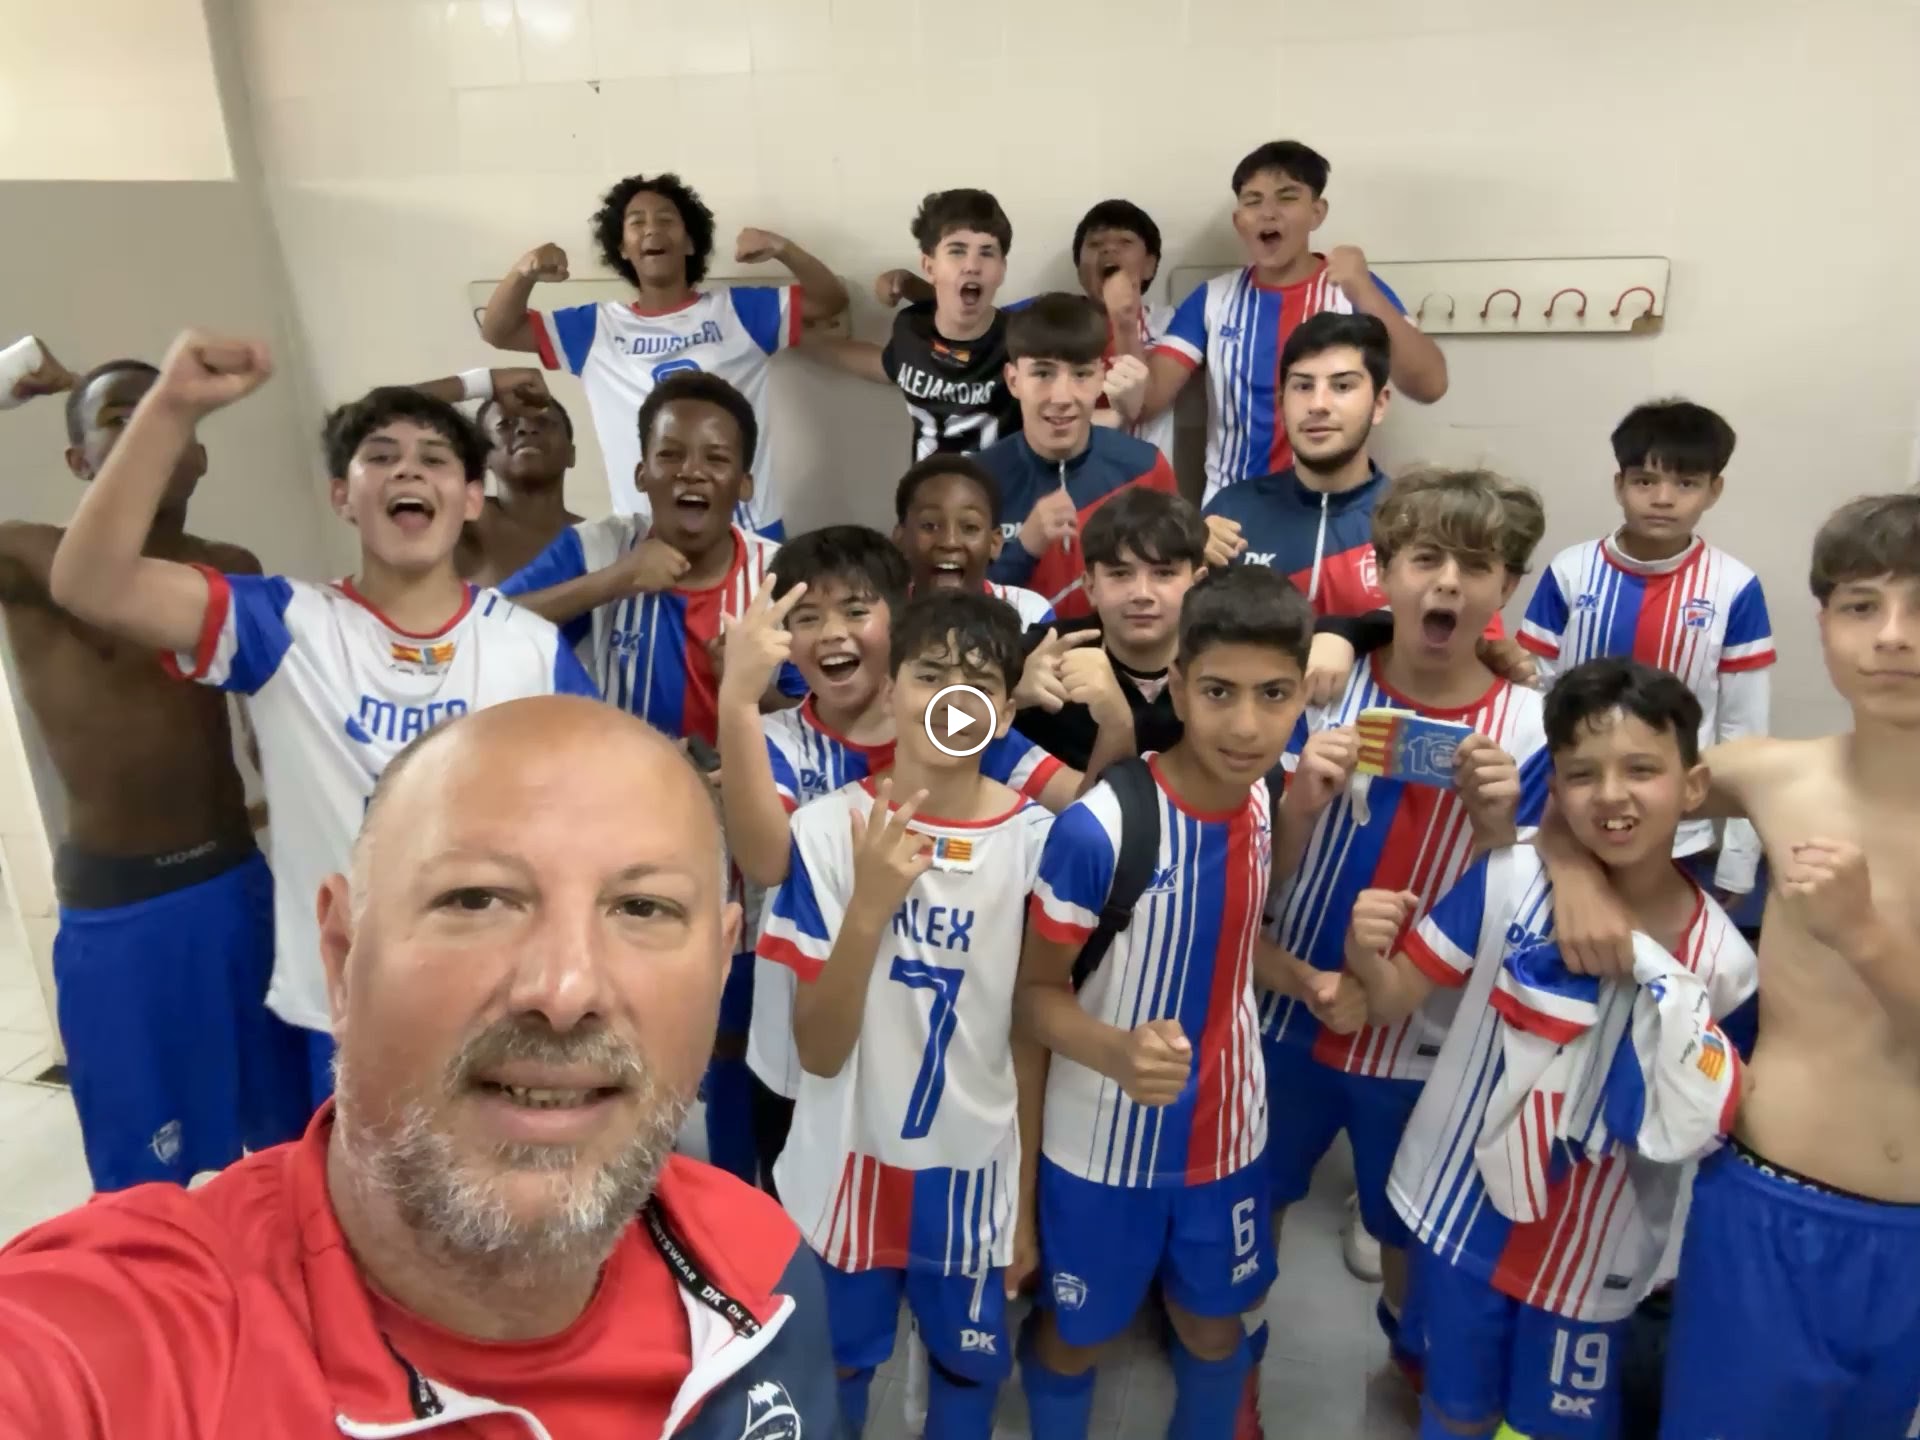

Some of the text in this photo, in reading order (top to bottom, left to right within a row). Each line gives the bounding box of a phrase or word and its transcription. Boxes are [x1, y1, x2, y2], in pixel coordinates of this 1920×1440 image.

[1244, 551, 1277, 568] DK
[800, 768, 829, 791] DK
[893, 898, 975, 953] ALEX
[888, 955, 967, 1140] 7
[1232, 1197, 1255, 1256] 6
[1231, 1251, 1260, 1284] DK
[701, 1285, 727, 1306] DK
[727, 1303, 744, 1320] DK
[960, 1328, 997, 1353] DK
[1550, 1328, 1609, 1390] 19
[1551, 1391, 1595, 1416] DK
